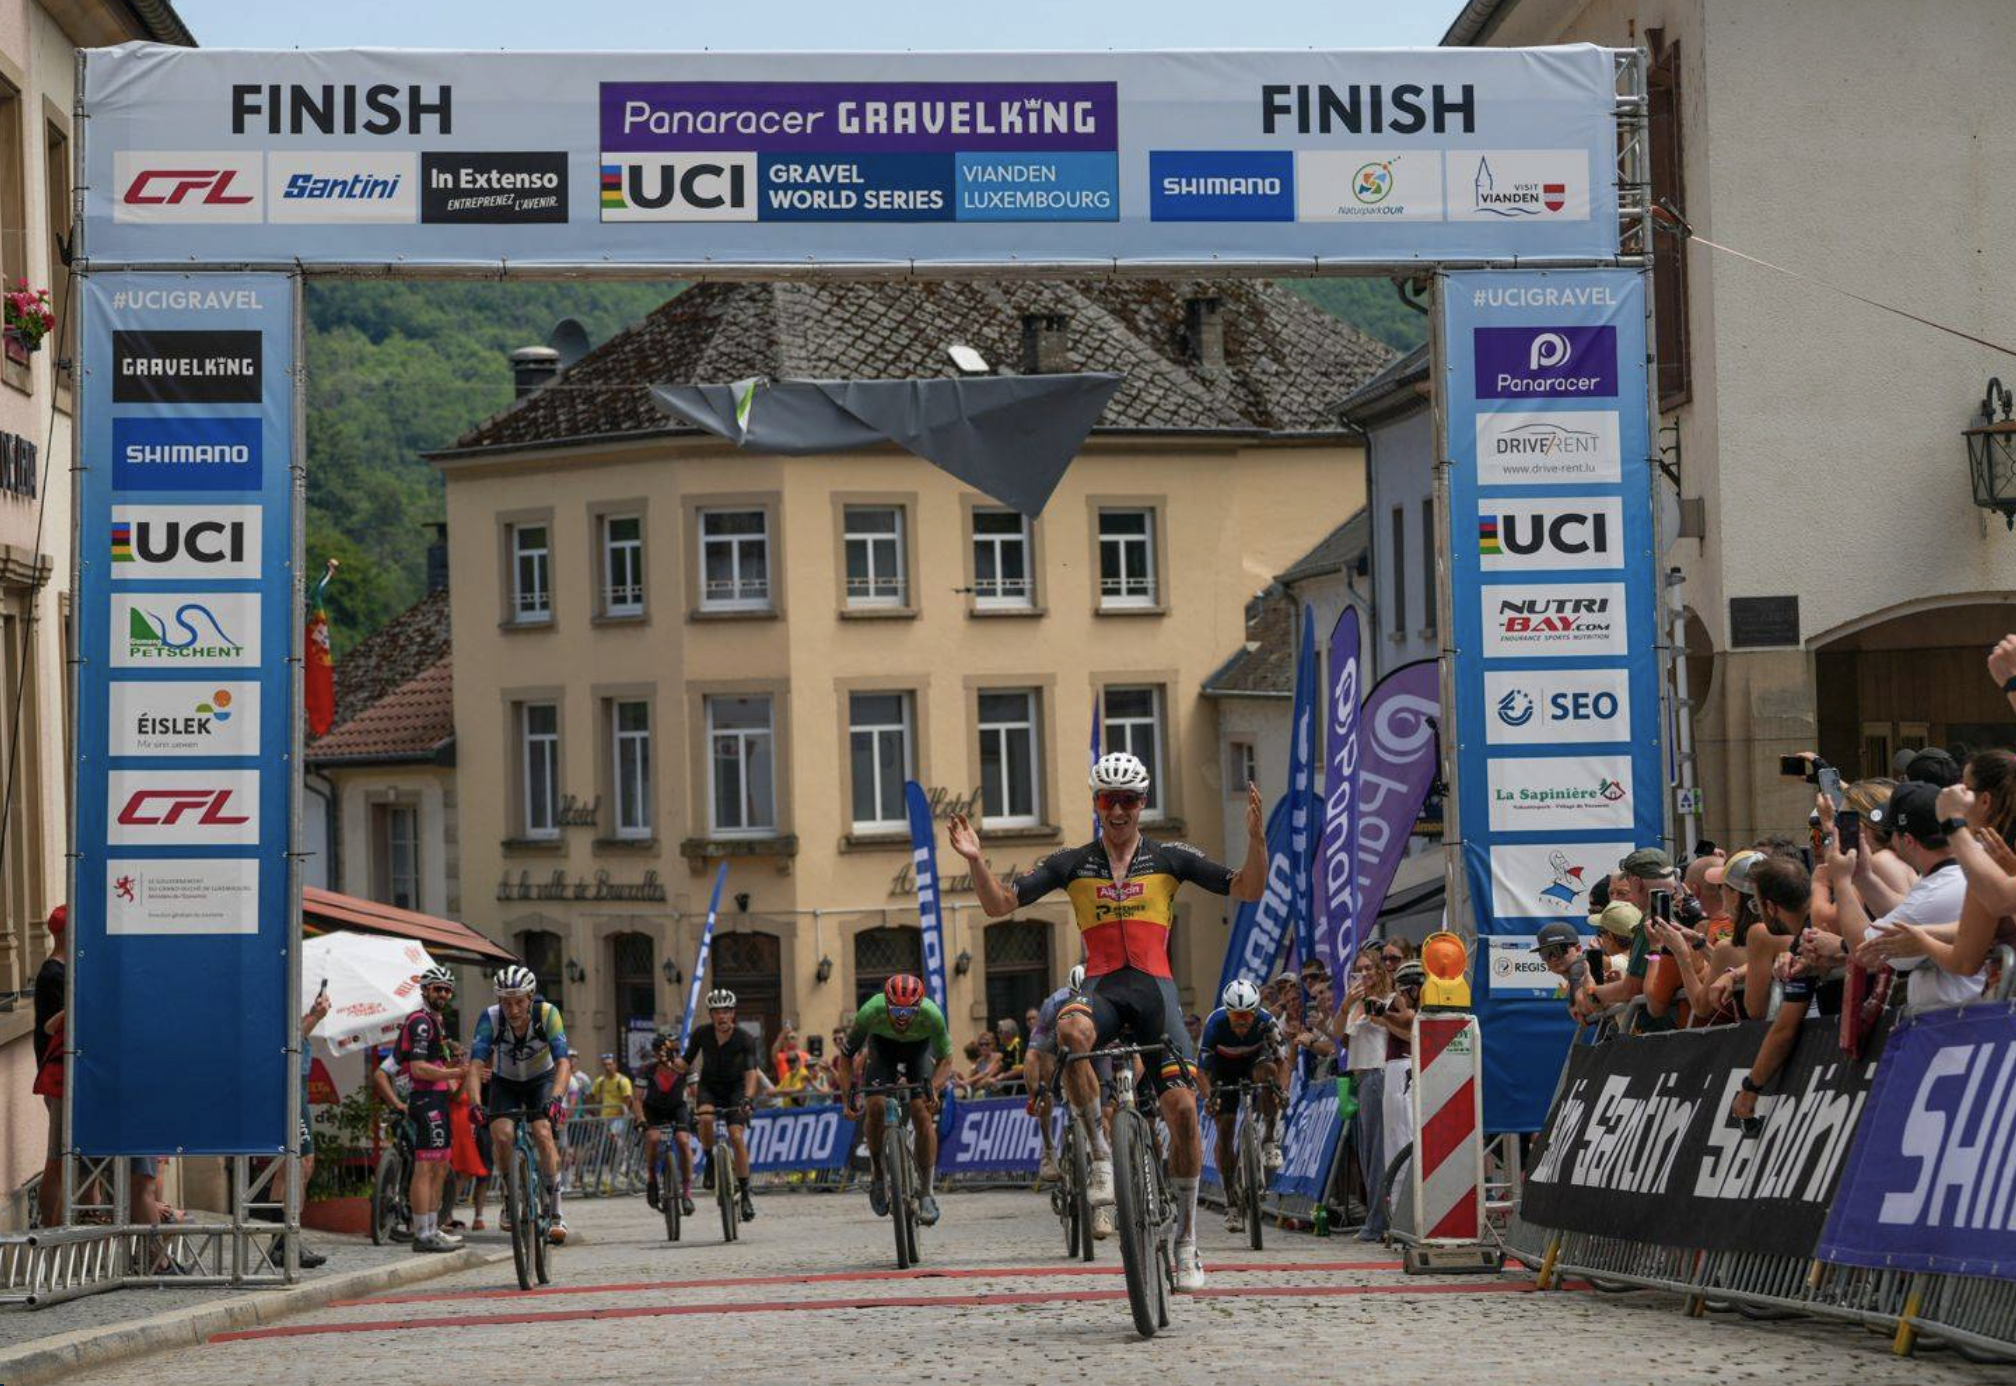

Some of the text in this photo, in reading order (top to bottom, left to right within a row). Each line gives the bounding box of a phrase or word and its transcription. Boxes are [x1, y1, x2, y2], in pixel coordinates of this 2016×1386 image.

[231, 83, 452, 135] FINISH
[624, 97, 1095, 135] Panaracer GRAVELKING
[1262, 84, 1475, 134] FINISH
[431, 168, 559, 189] In Extenso
[769, 165, 865, 184] GRAVEL
[963, 165, 1056, 183] VIANDEN
[124, 170, 254, 204] CFL
[283, 174, 401, 199] Santini
[628, 163, 745, 209] UCI
[1163, 177, 1281, 195] SHIMANO
[447, 193, 515, 211] ENTREPRENEZ
[769, 190, 944, 210] WORLD SERIES
[963, 191, 1111, 209] LUXEMBOURG
[113, 290, 263, 310] #UCIGRAVEL
[1473, 287, 1617, 307] #UCIGRAVEL
[122, 357, 254, 376] GRAVELKING
[1497, 374, 1600, 392] Panaracer
[126, 445, 249, 463] SHIMANO
[1503, 463, 1595, 475] www.drive-rent.lu
[136, 521, 244, 563] UCI
[1503, 513, 1607, 555] UCI
[1500, 598, 1609, 614] NUTRI
[130, 646, 244, 657] PETSCHENT
[1550, 692, 1618, 720] SEO
[137, 712, 211, 735] ÉISLEK
[1496, 787, 1597, 802] La Sapinière
[117, 790, 250, 825] CFL
[1515, 963, 1547, 972] REGIS
[430, 1120, 446, 1148] LCR
[747, 1112, 838, 1163] MANO
[1571, 1073, 1712, 1194] Santini
[1693, 1062, 1878, 1202] Santini
